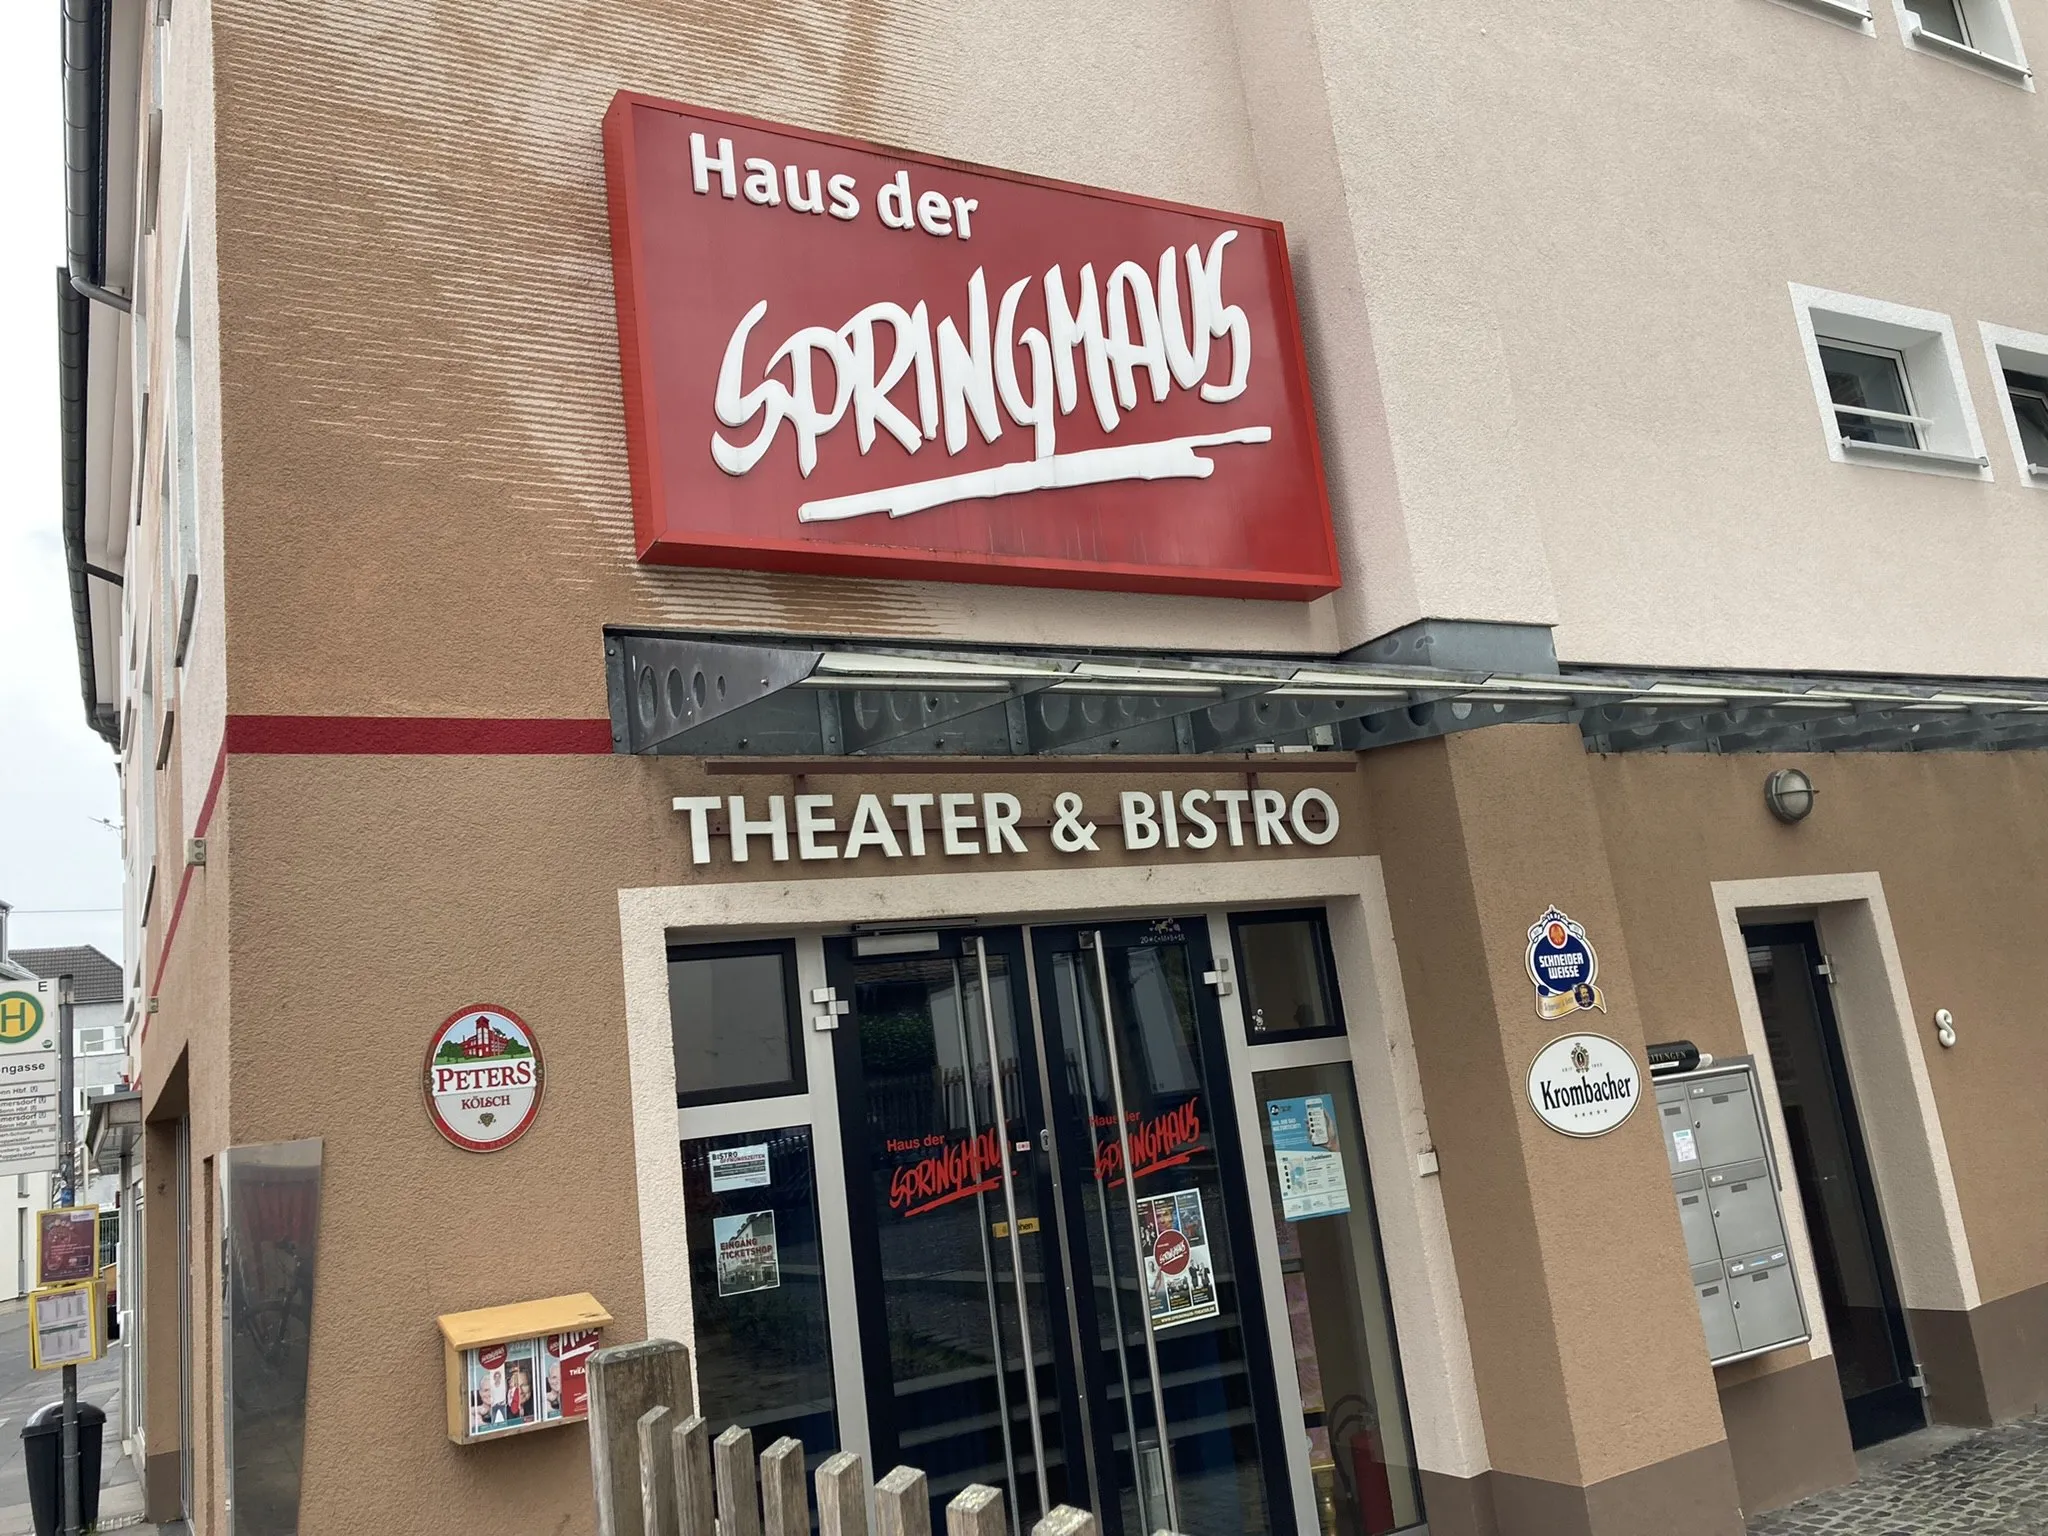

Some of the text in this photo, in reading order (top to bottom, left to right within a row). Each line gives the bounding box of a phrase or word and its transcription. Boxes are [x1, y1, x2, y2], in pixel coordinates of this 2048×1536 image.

[689, 132, 979, 240] Haus der
[711, 230, 1252, 479] SPRINGMAUS
[673, 787, 1340, 865] THEATER & BISTRO
[1539, 953, 1584, 968] SCHNEIDER
[1548, 966, 1580, 979] WEISSE
[38, 981, 48, 992] E
[1935, 1008, 1956, 1047] 8
[1, 1063, 46, 1075] ngasse
[436, 1061, 531, 1093] PETERS
[1540, 1072, 1631, 1110] Krombacher
[1, 1098, 37, 1107] mersdorf
[462, 1095, 510, 1110] KÖLSCH
[1, 1113, 37, 1122] mersdorf
[887, 1134, 945, 1152] Haus der
[712, 1151, 738, 1160] BISTRO
[720, 1238, 757, 1250] EINGANG
[720, 1245, 773, 1260] TICKETSHOP
[569, 1368, 587, 1376] THEA
